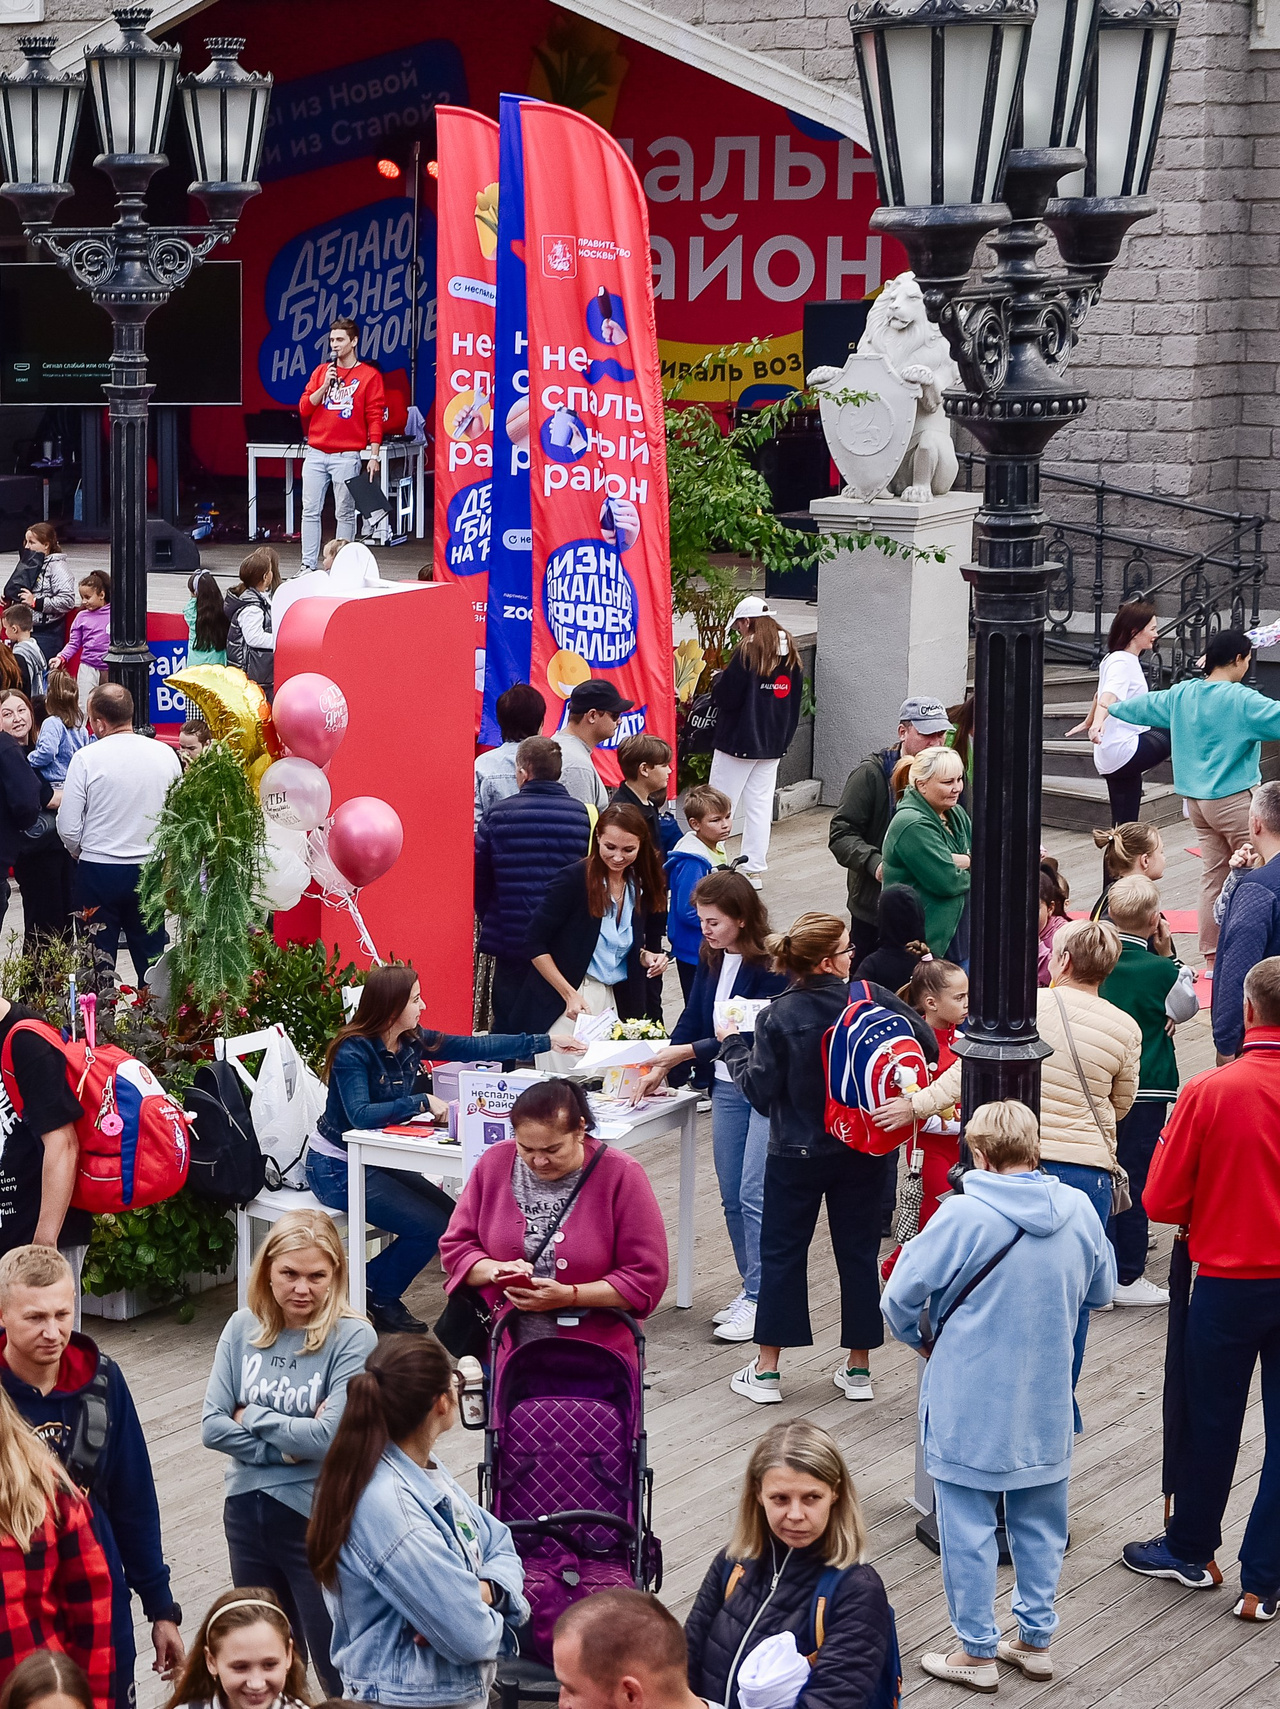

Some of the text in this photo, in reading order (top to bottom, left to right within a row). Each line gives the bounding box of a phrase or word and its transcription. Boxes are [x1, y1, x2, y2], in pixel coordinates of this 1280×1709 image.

[328, 59, 419, 111] Новой
[620, 135, 881, 203] альн
[279, 212, 414, 321] ДЕЛАЮ
[651, 213, 882, 302] айон
[289, 255, 428, 342] БИЗНЕС
[464, 284, 496, 300] неспаль
[271, 297, 438, 383] НА РЙОНЕ
[41, 362, 63, 370] Сигнал
[63, 362, 85, 370] слабый
[753, 352, 803, 380] воз
[451, 543, 474, 565] НА
[156, 686, 187, 711] Во
[267, 790, 287, 806] ТЫ
[488, 1099, 515, 1110] райо
[0, 1184, 17, 1194] very
[288, 1359, 297, 1370] A
[240, 1352, 322, 1414] Perfect
